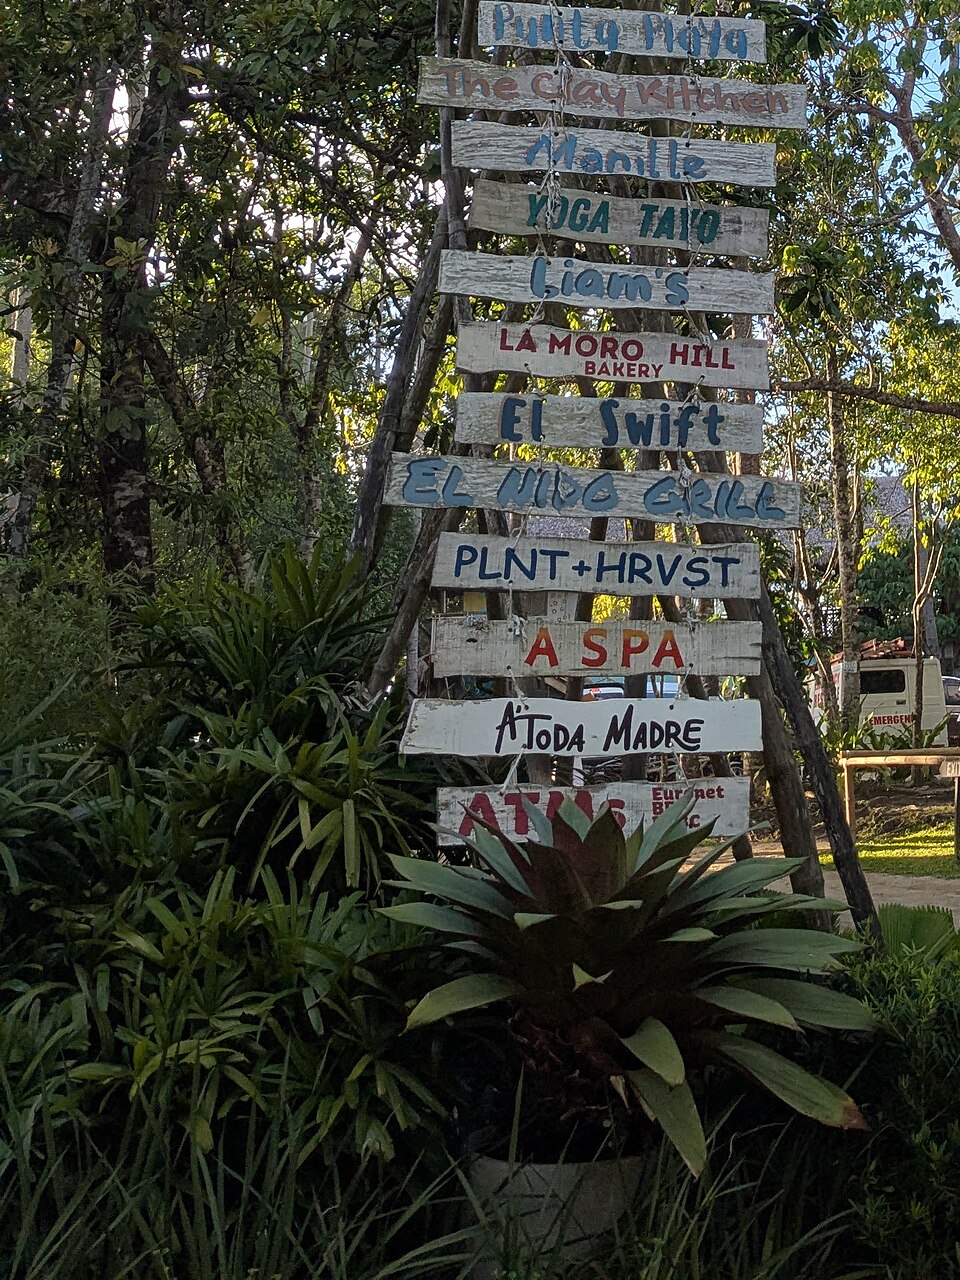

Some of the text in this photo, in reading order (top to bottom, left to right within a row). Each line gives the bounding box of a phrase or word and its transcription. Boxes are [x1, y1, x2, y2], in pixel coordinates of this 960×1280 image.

[440, 65, 789, 117] The Clay Kitchen
[527, 194, 721, 244] YOGA TAYO
[530, 256, 690, 306] Liam's
[499, 328, 736, 370] LA MORO HILL
[584, 360, 664, 379] BAKERY
[500, 397, 726, 448] El Swift
[402, 457, 786, 520] EL NIDO GRILL
[454, 544, 741, 588] PLNT+HRVST
[524, 626, 684, 669] A SPA
[602, 704, 705, 752] MADRE
[869, 715, 914, 726] EMERGEN
